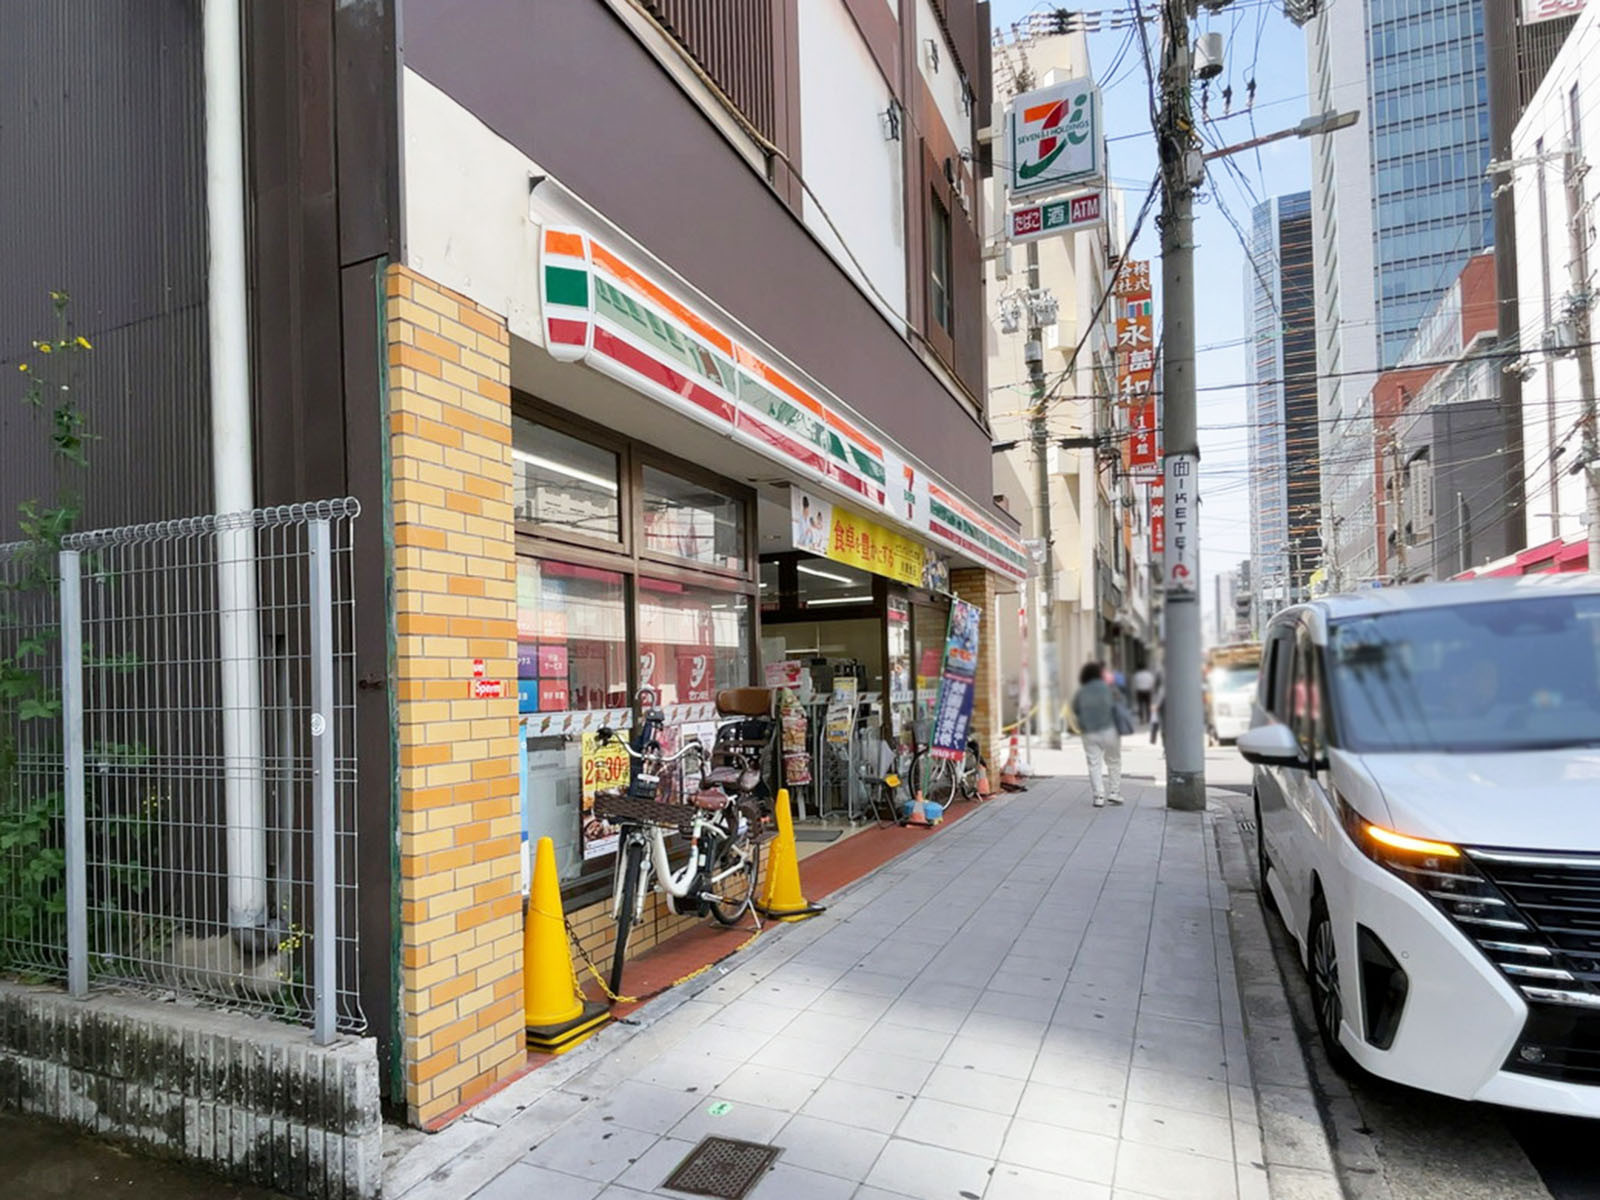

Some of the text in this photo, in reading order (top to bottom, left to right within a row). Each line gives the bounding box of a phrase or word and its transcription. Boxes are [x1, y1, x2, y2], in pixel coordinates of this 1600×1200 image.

[1049, 119, 1090, 137] HOLDINGS
[1047, 204, 1066, 227] 酒
[1072, 196, 1099, 219] ATM
